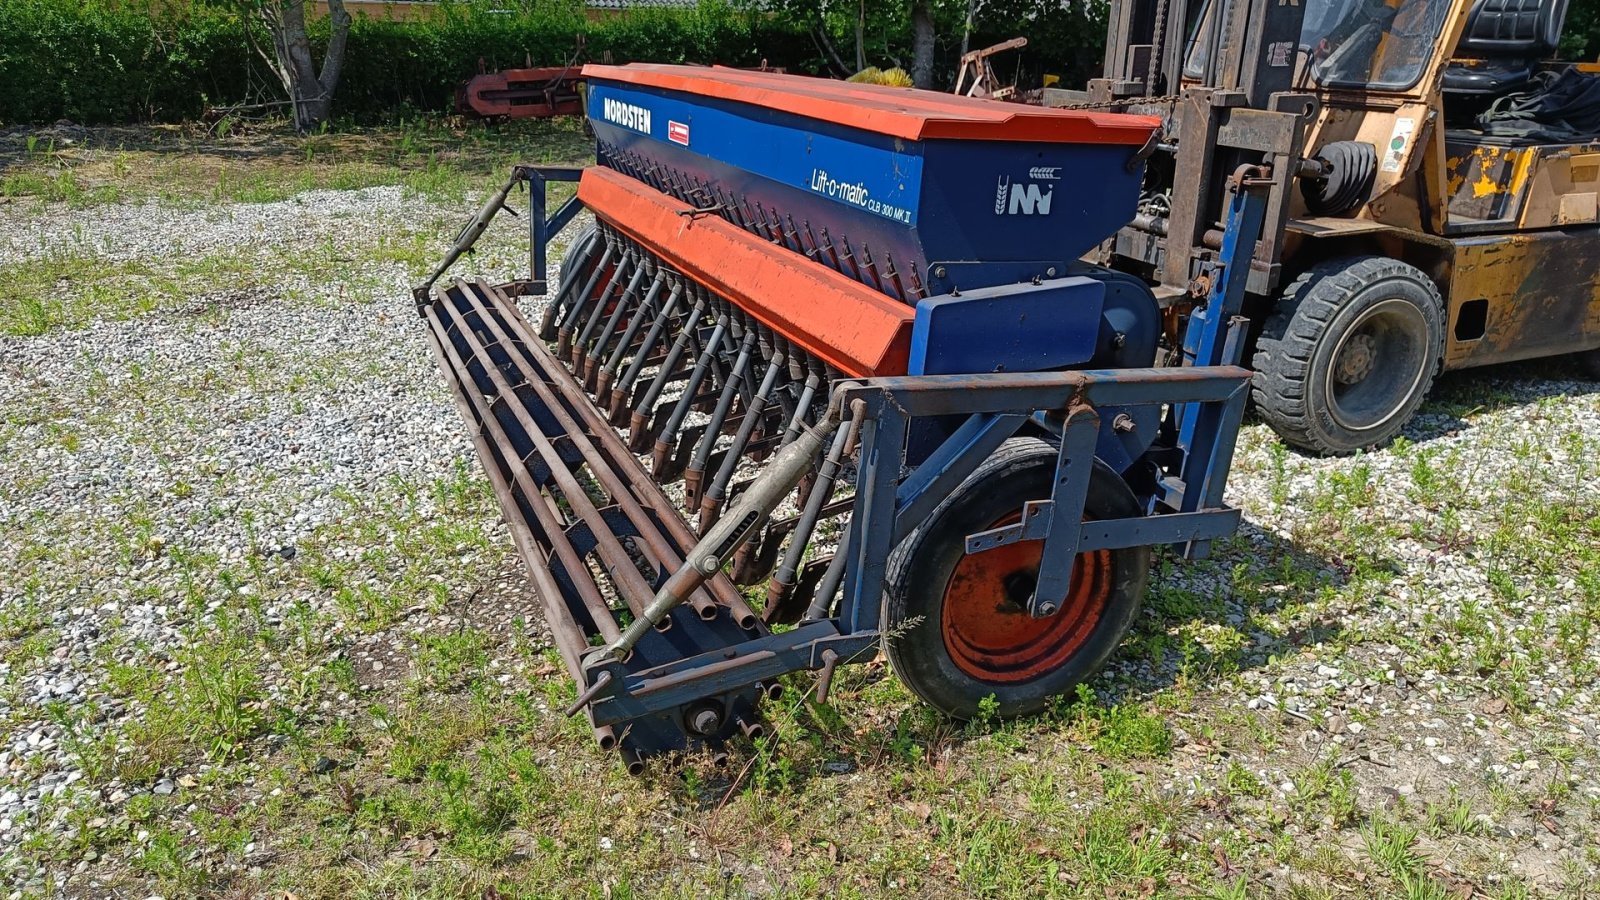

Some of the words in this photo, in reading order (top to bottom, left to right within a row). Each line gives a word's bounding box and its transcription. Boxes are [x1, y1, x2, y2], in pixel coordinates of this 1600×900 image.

[604, 97, 651, 134] NORDSTEN
[811, 168, 868, 207] Lift-o-matic
[867, 199, 881, 213] CLB
[881, 204, 894, 218] 300
[893, 207, 905, 221] MK
